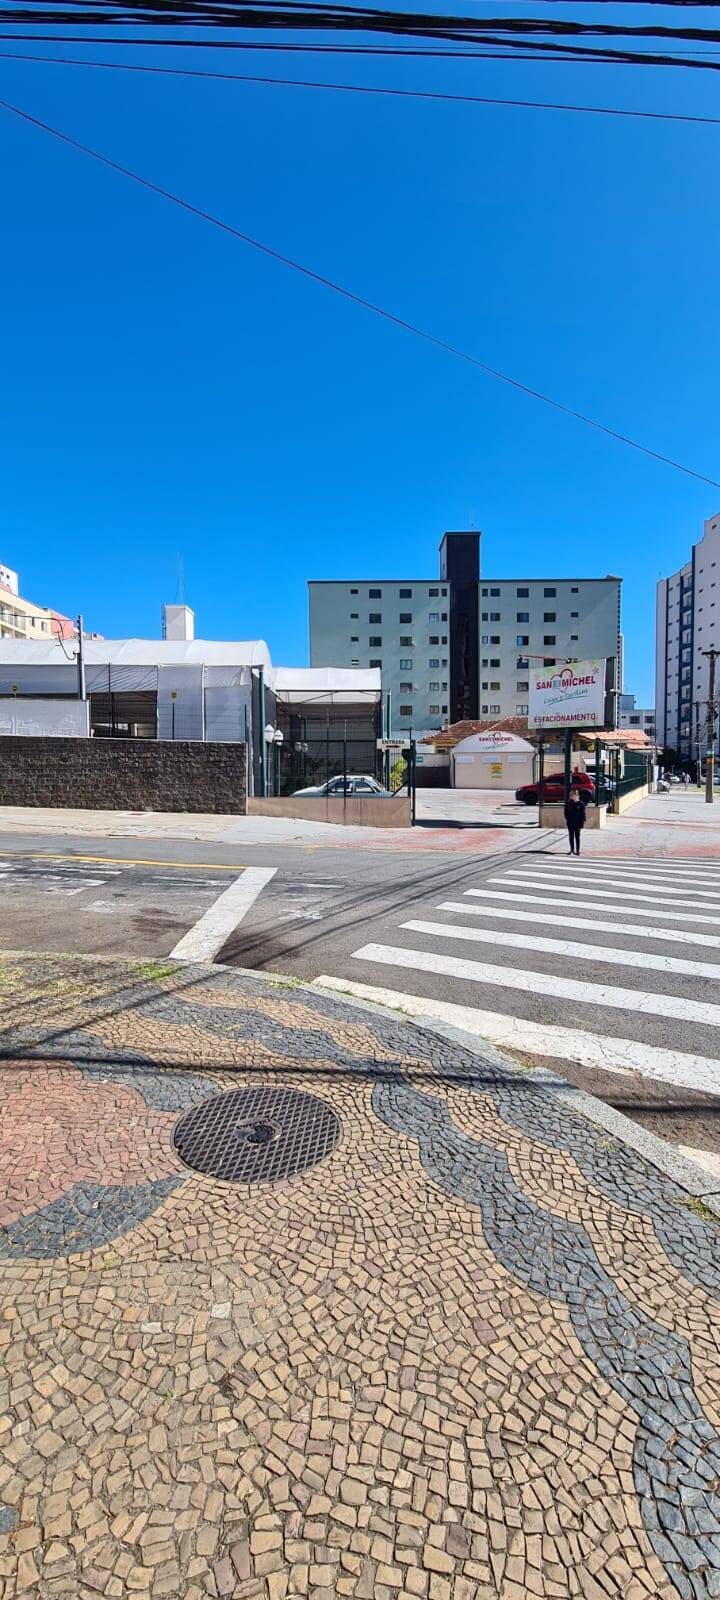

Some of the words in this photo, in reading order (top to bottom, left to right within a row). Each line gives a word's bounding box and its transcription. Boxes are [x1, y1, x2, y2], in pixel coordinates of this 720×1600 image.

[536, 681, 552, 690] SAN
[562, 676, 596, 687] MICHEL
[534, 713, 596, 723] ESTACIONAMENTO
